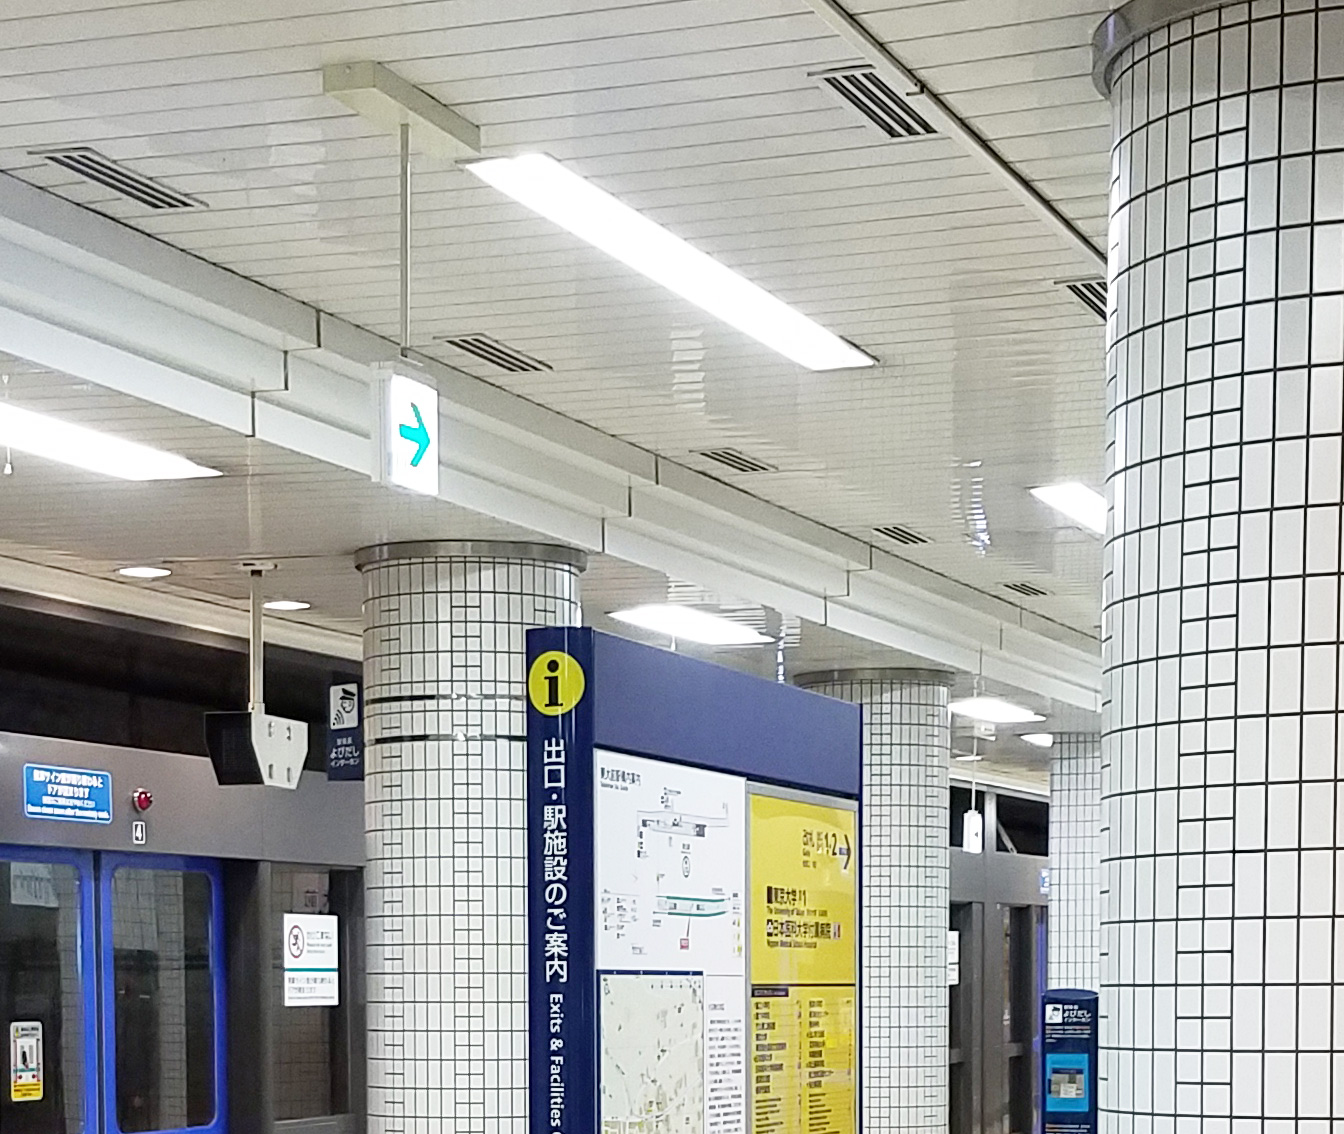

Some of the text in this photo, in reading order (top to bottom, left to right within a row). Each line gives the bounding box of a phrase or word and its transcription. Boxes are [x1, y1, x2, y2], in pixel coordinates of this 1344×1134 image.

[135, 825, 143, 841] 4
[544, 738, 568, 983] 出口・駅施設のご案内
[550, 993, 564, 1033] Exits
[550, 1038, 564, 1050] &
[550, 1055, 565, 1128] Facilities
